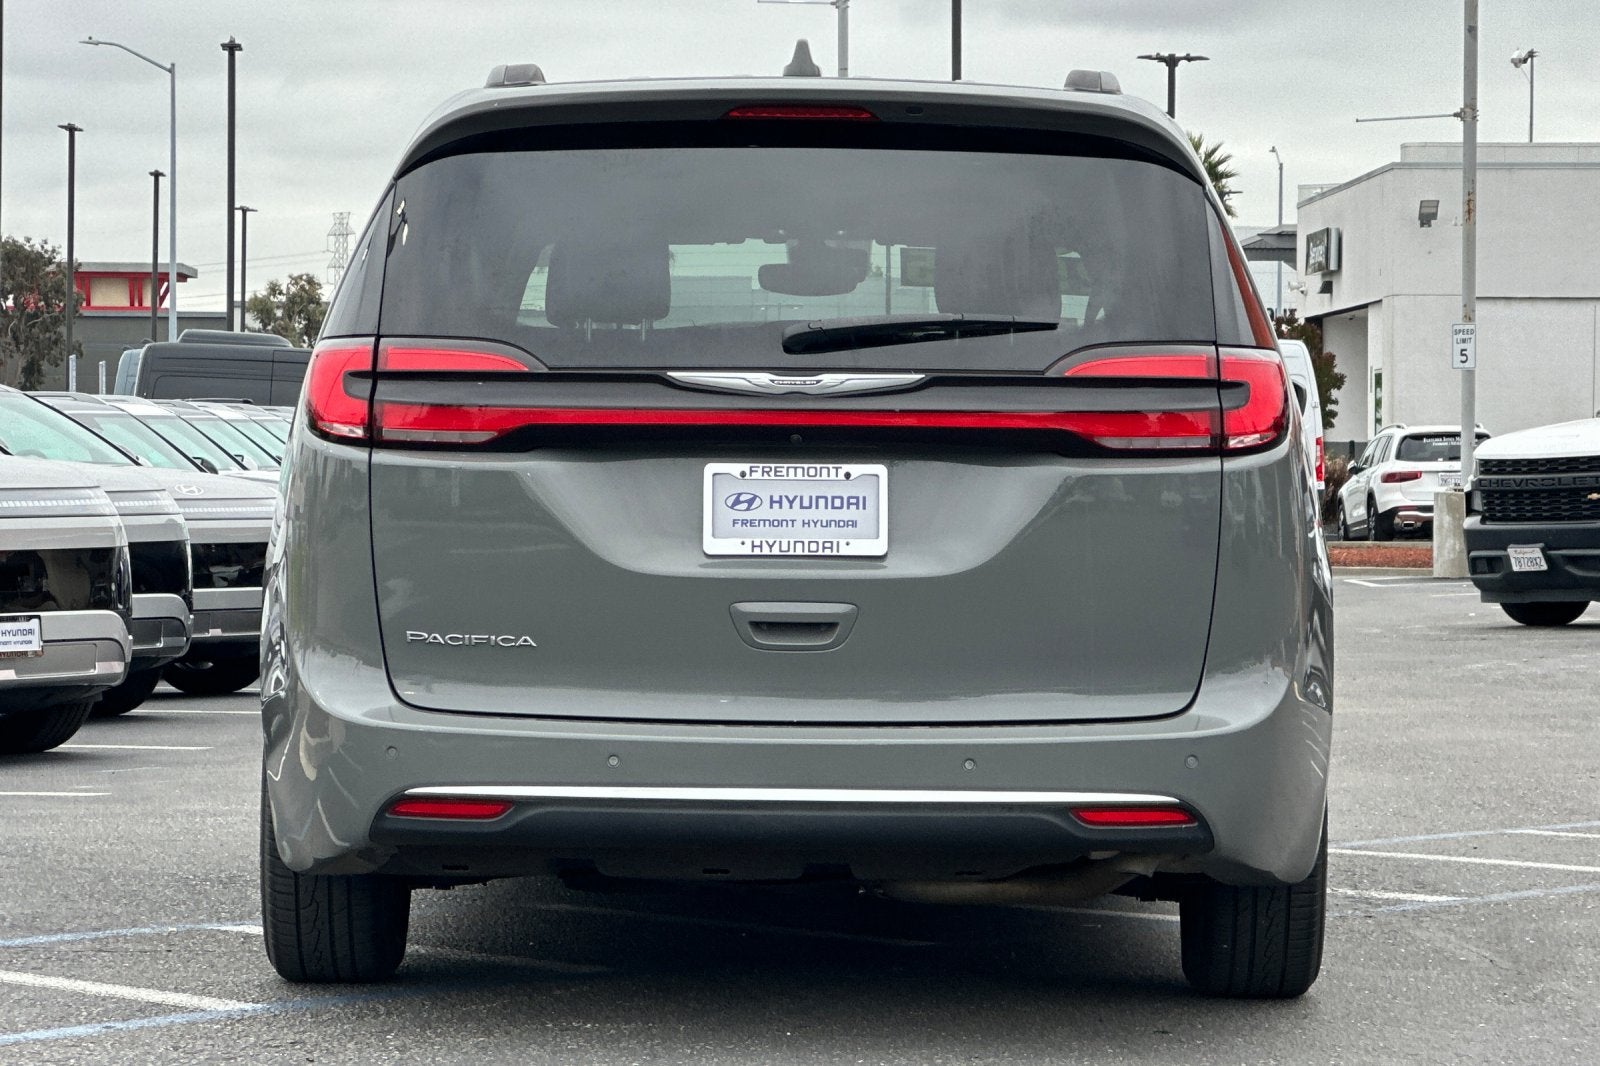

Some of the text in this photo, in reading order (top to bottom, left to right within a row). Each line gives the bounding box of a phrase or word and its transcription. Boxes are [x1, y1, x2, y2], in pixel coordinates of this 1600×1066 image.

[1454, 328, 1475, 336] SPEED
[1455, 337, 1472, 345] LIMIT
[1460, 348, 1469, 364] 5
[749, 465, 843, 478] FREMONT
[1479, 477, 1600, 488] CHEVROLET
[769, 495, 867, 510] HYUNDAI
[732, 518, 858, 529] FREMONT HYUNDAI
[751, 540, 840, 553] HYUNDAI
[1, 628, 35, 637] HYUNDAI
[406, 630, 537, 647] PACIFICA
